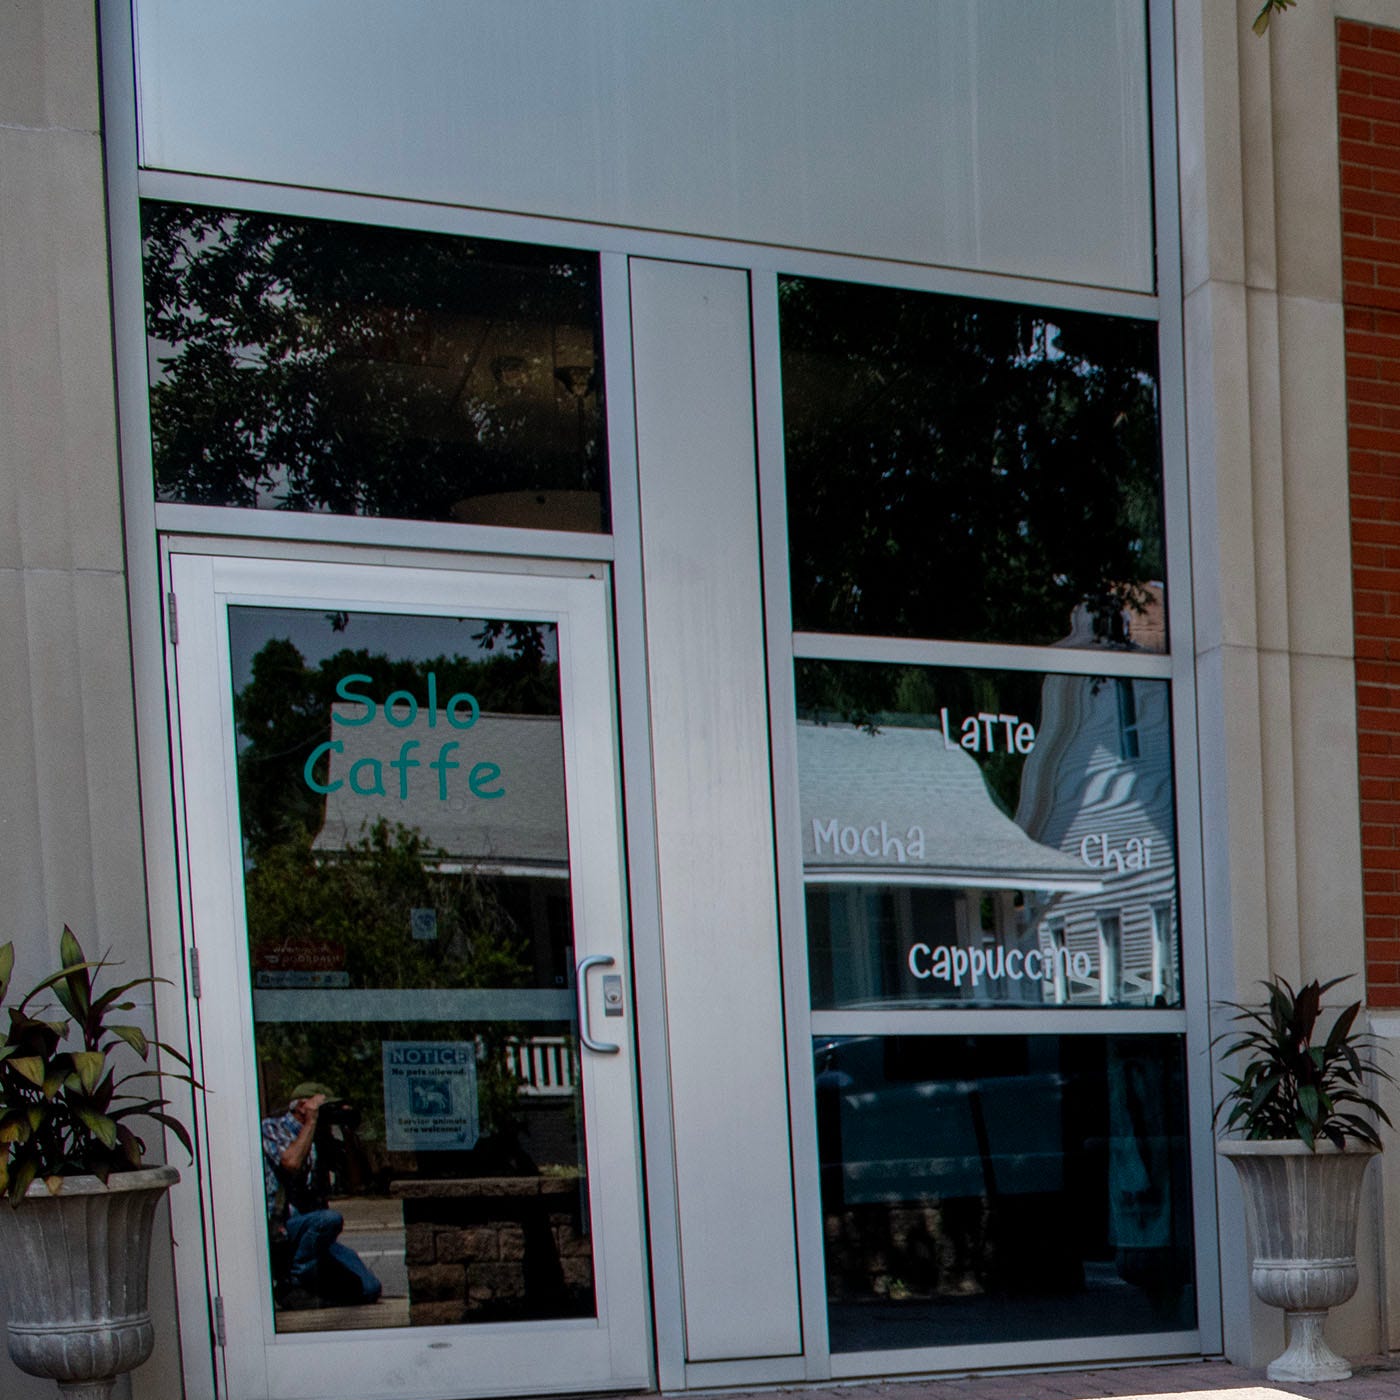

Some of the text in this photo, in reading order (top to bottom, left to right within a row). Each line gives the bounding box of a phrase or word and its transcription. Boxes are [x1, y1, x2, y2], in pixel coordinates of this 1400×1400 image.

[331, 672, 480, 730] Solo
[304, 740, 505, 800] Caffe
[811, 818, 926, 862] Mocha
[1080, 833, 1153, 873] Chai
[908, 942, 1093, 987] Cappuccino
[391, 1049, 467, 1064] NOTICE
[407, 1069, 426, 1077] pets
